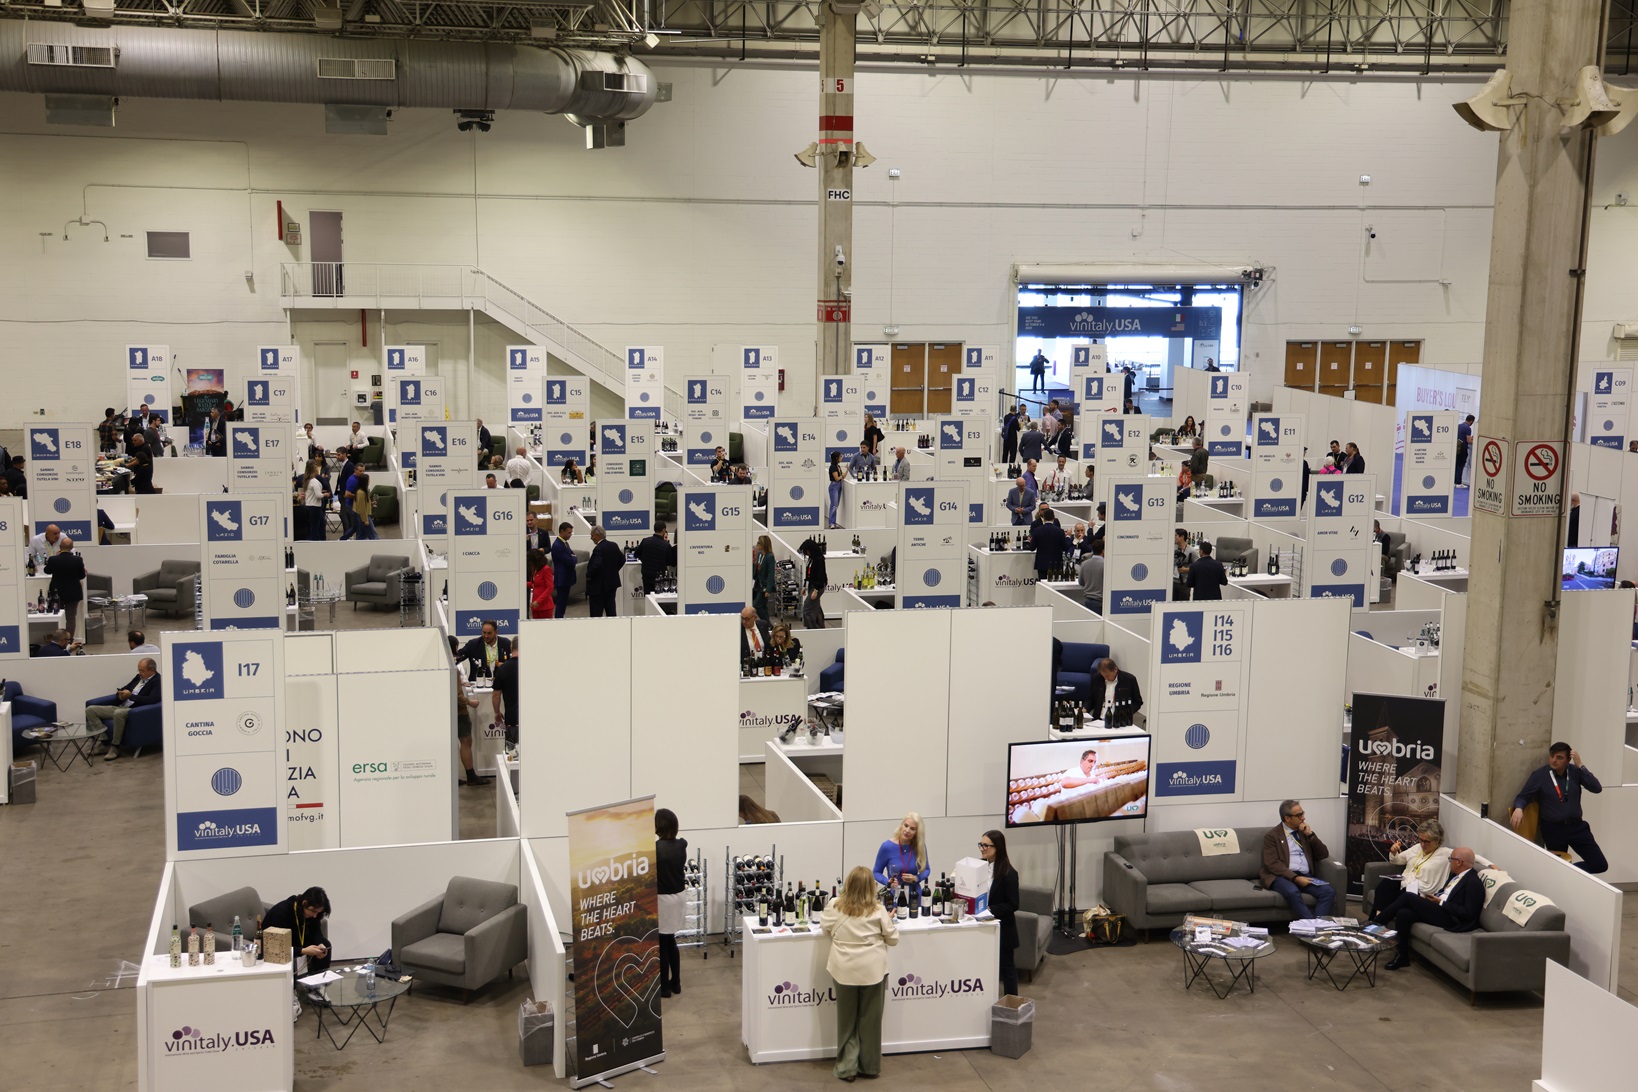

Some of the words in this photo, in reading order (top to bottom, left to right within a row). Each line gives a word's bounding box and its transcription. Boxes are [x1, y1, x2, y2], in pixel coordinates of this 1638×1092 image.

[836, 79, 844, 92] 5
[828, 190, 850, 200] FHC
[1070, 318, 1142, 333] vinitaly.USA
[1417, 387, 1443, 406] BUYER'S
[1486, 478, 1494, 489] NO
[1533, 482, 1546, 493] NO
[1348, 494, 1364, 503] G12
[1478, 488, 1502, 503] SMOKING
[1518, 494, 1560, 505] SMOKING
[940, 502, 957, 511] G14
[1148, 498, 1164, 506] G13
[493, 511, 512, 520] G16
[722, 507, 740, 516] G15
[249, 516, 269, 526] G17
[1214, 615, 1234, 627] I14
[1213, 629, 1233, 641] I15
[1212, 644, 1232, 656] I16
[238, 663, 260, 676] I17
[1358, 738, 1434, 760] umbria
[352, 762, 387, 773] ersa
[1358, 761, 1397, 773] WHERE
[1169, 774, 1222, 786] vinitaly.USA
[1358, 773, 1379, 784] THE
[1381, 775, 1417, 787] HEART
[1357, 784, 1393, 796] BEATS.
[194, 824, 261, 837] vinitaly.USA
[578, 852, 649, 889] umbria
[580, 891, 617, 910] WHERE
[580, 909, 600, 925] THE
[602, 901, 636, 920] HEART
[580, 924, 615, 941] BEATS.
[892, 978, 984, 998] vinitaly.USA
[768, 988, 836, 1006] vinitaly.U
[165, 1029, 275, 1052] vinitaly.USA
